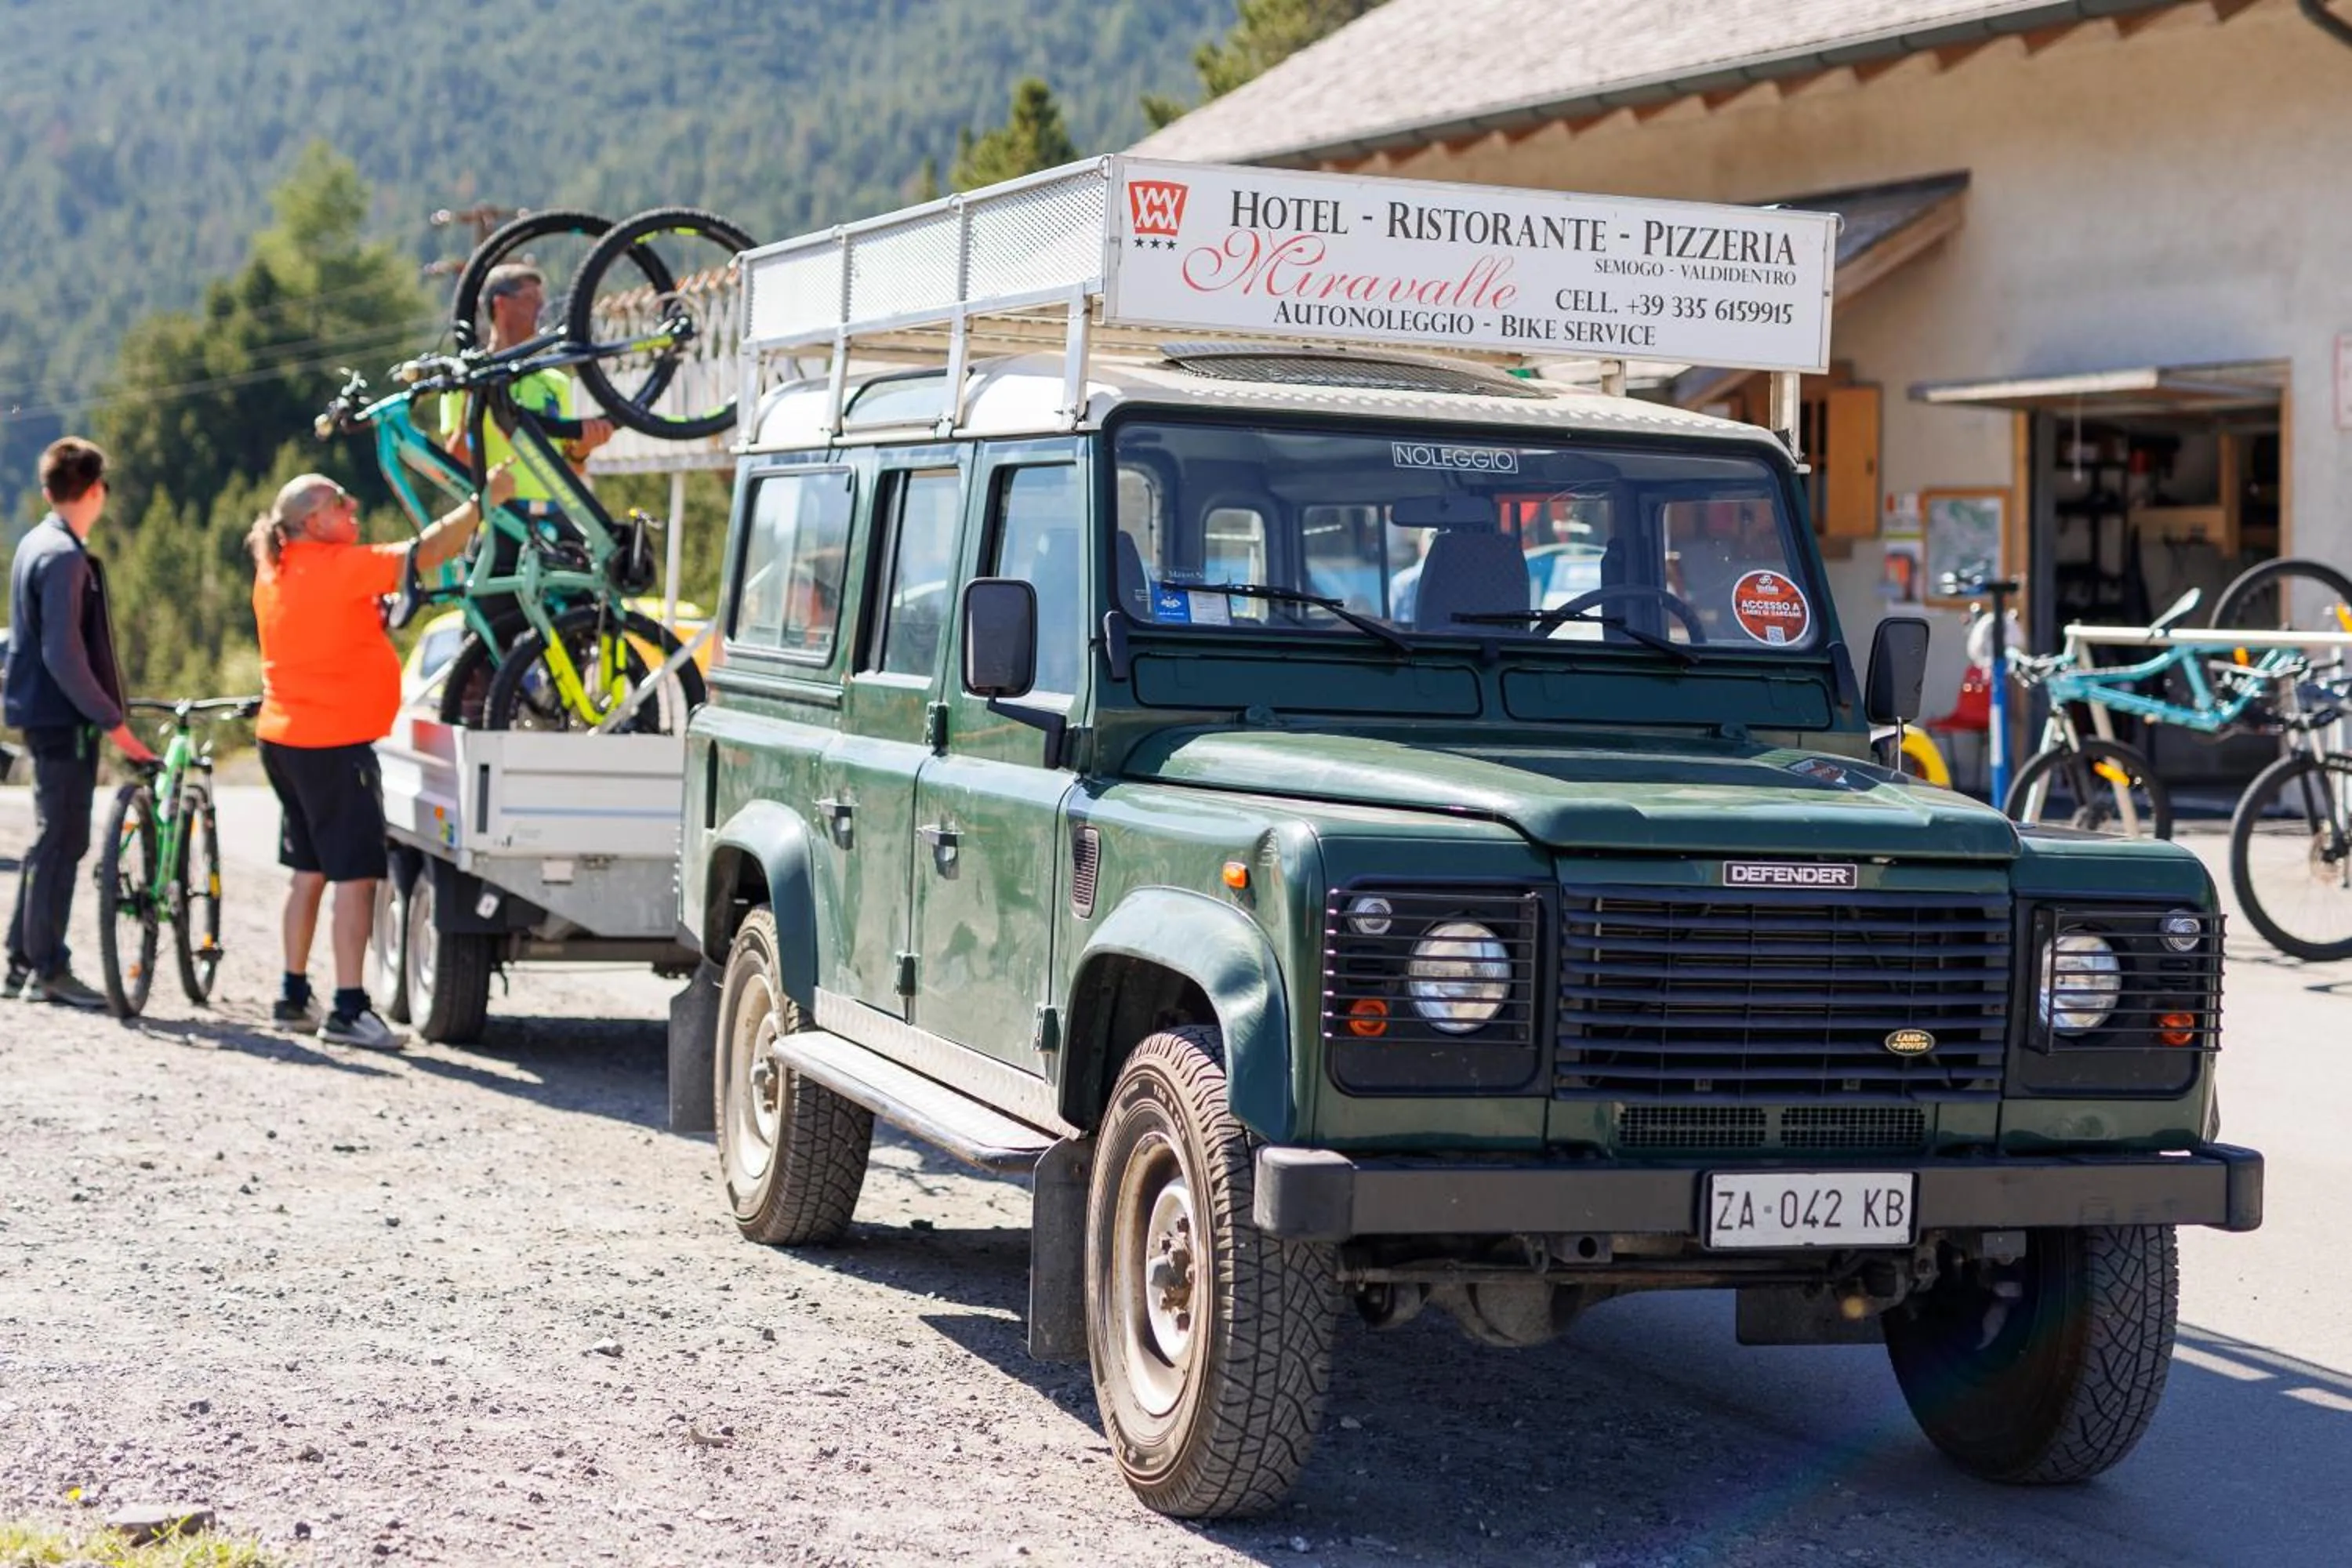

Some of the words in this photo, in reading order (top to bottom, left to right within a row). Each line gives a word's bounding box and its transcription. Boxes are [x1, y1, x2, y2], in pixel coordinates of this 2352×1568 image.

[1231, 190, 1348, 234] HOTEL
[1386, 201, 1607, 252] RISTORANTE
[1643, 220, 1797, 266] PIZZERIA
[1182, 228, 1519, 310] Miravalle
[1594, 258, 1664, 277] SEMOGO
[1680, 263, 1797, 286] VALDIDENTRO
[1273, 300, 1474, 335] AUTONOLEGGIO
[1501, 314, 1556, 339] BIKE
[1564, 320, 1656, 346] SERVICE
[1555, 289, 1618, 314] CELL.
[1625, 294, 1665, 317] +39
[1671, 296, 1708, 319] 335
[1715, 299, 1794, 325] 6159915
[1396, 445, 1513, 470] NOLEGGIO
[1732, 866, 1847, 884] DEFENDER
[1716, 1191, 1755, 1230] ZA
[1780, 1189, 1842, 1229] 042
[1864, 1189, 1904, 1227] KB
